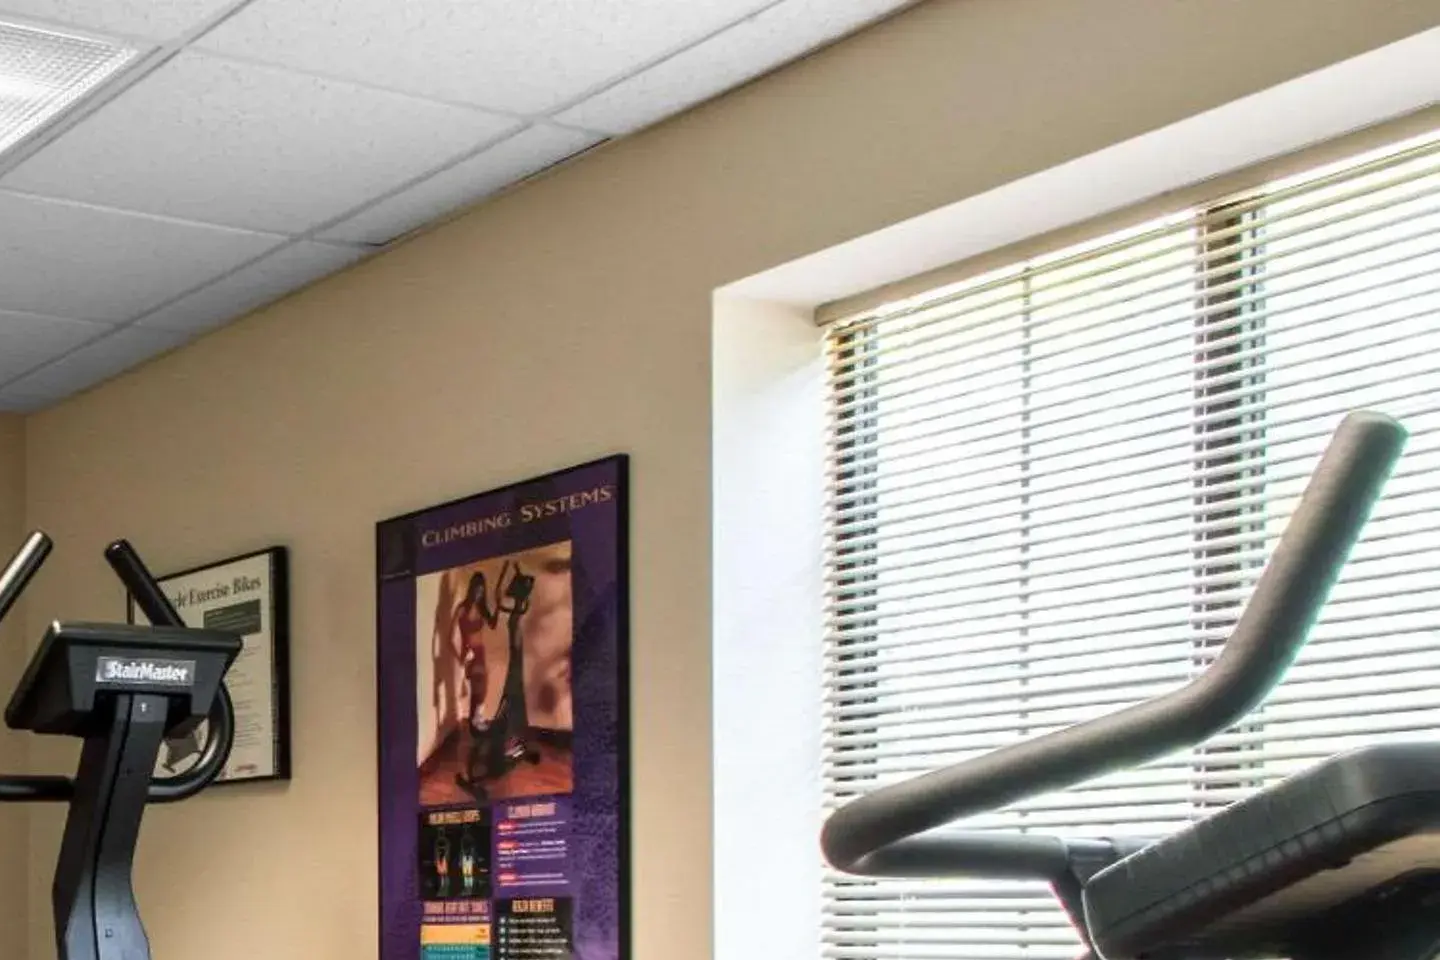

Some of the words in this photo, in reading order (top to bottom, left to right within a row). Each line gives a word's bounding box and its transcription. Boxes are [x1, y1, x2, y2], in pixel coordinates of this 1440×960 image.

[421, 511, 511, 548] CLIMBING
[520, 485, 614, 523] SYSTEMS
[189, 582, 231, 606] Exercise
[104, 660, 188, 682] StairMaster
